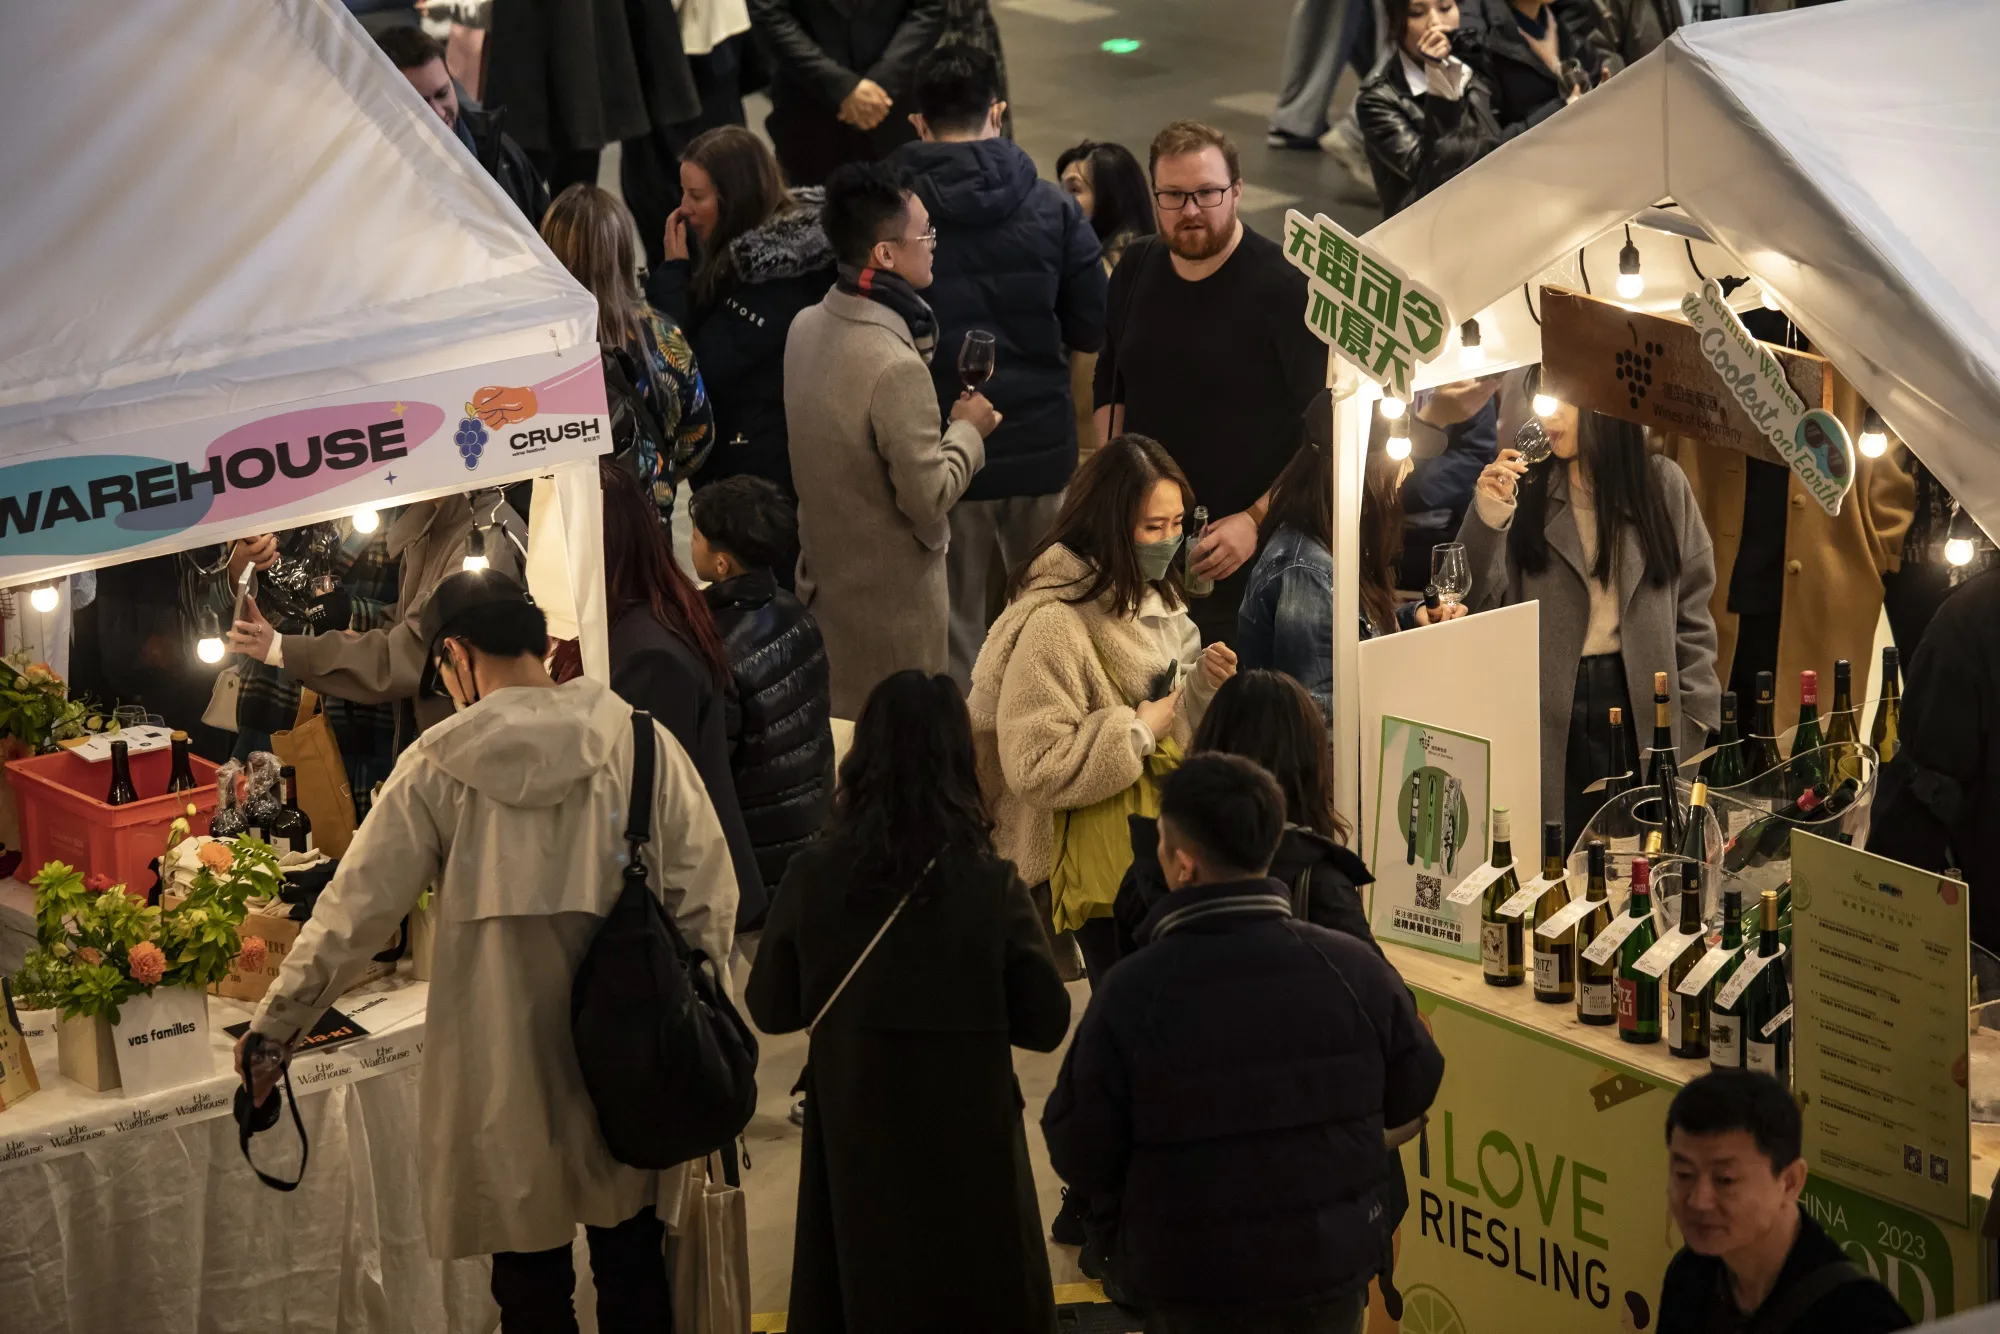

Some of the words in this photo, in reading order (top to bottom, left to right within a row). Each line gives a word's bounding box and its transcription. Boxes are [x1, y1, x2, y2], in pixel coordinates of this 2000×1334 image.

[1288, 219, 1444, 354] 无雷司令
[1703, 283, 1755, 360] German
[1759, 351, 1800, 415] Wines
[1683, 297, 1704, 328] the
[1702, 327, 1780, 431] Coolest
[1772, 429, 1793, 457] on
[1793, 451, 1840, 511] Earth
[509, 418, 600, 450] CRUSH
[1653, 402, 1683, 424] Wines
[1697, 417, 1742, 443] Germany
[0, 419, 408, 537] WAREHOUSE
[1394, 917, 1461, 943] 送精美葡萄酒开瓶器
[128, 1032, 148, 1047] vos
[151, 1021, 196, 1042] familles
[360, 1048, 410, 1069] Warehouse
[376, 1045, 393, 1057] the
[298, 1065, 352, 1086] Warehouse
[316, 1061, 334, 1073] the
[175, 1096, 229, 1118] Warehouse
[193, 1092, 211, 1104] the
[114, 1112, 169, 1133] Warehouse
[133, 1108, 151, 1120] the
[50, 1129, 106, 1148] Warehouse
[69, 1124, 88, 1136] the
[0, 1144, 43, 1161] arehouse
[6, 1140, 25, 1152] the
[1444, 1110, 1609, 1252] LOVE
[1797, 1192, 1849, 1232] HINA
[1420, 1188, 1610, 1309] RIESLING
[1877, 1220, 1926, 1260] 2023
